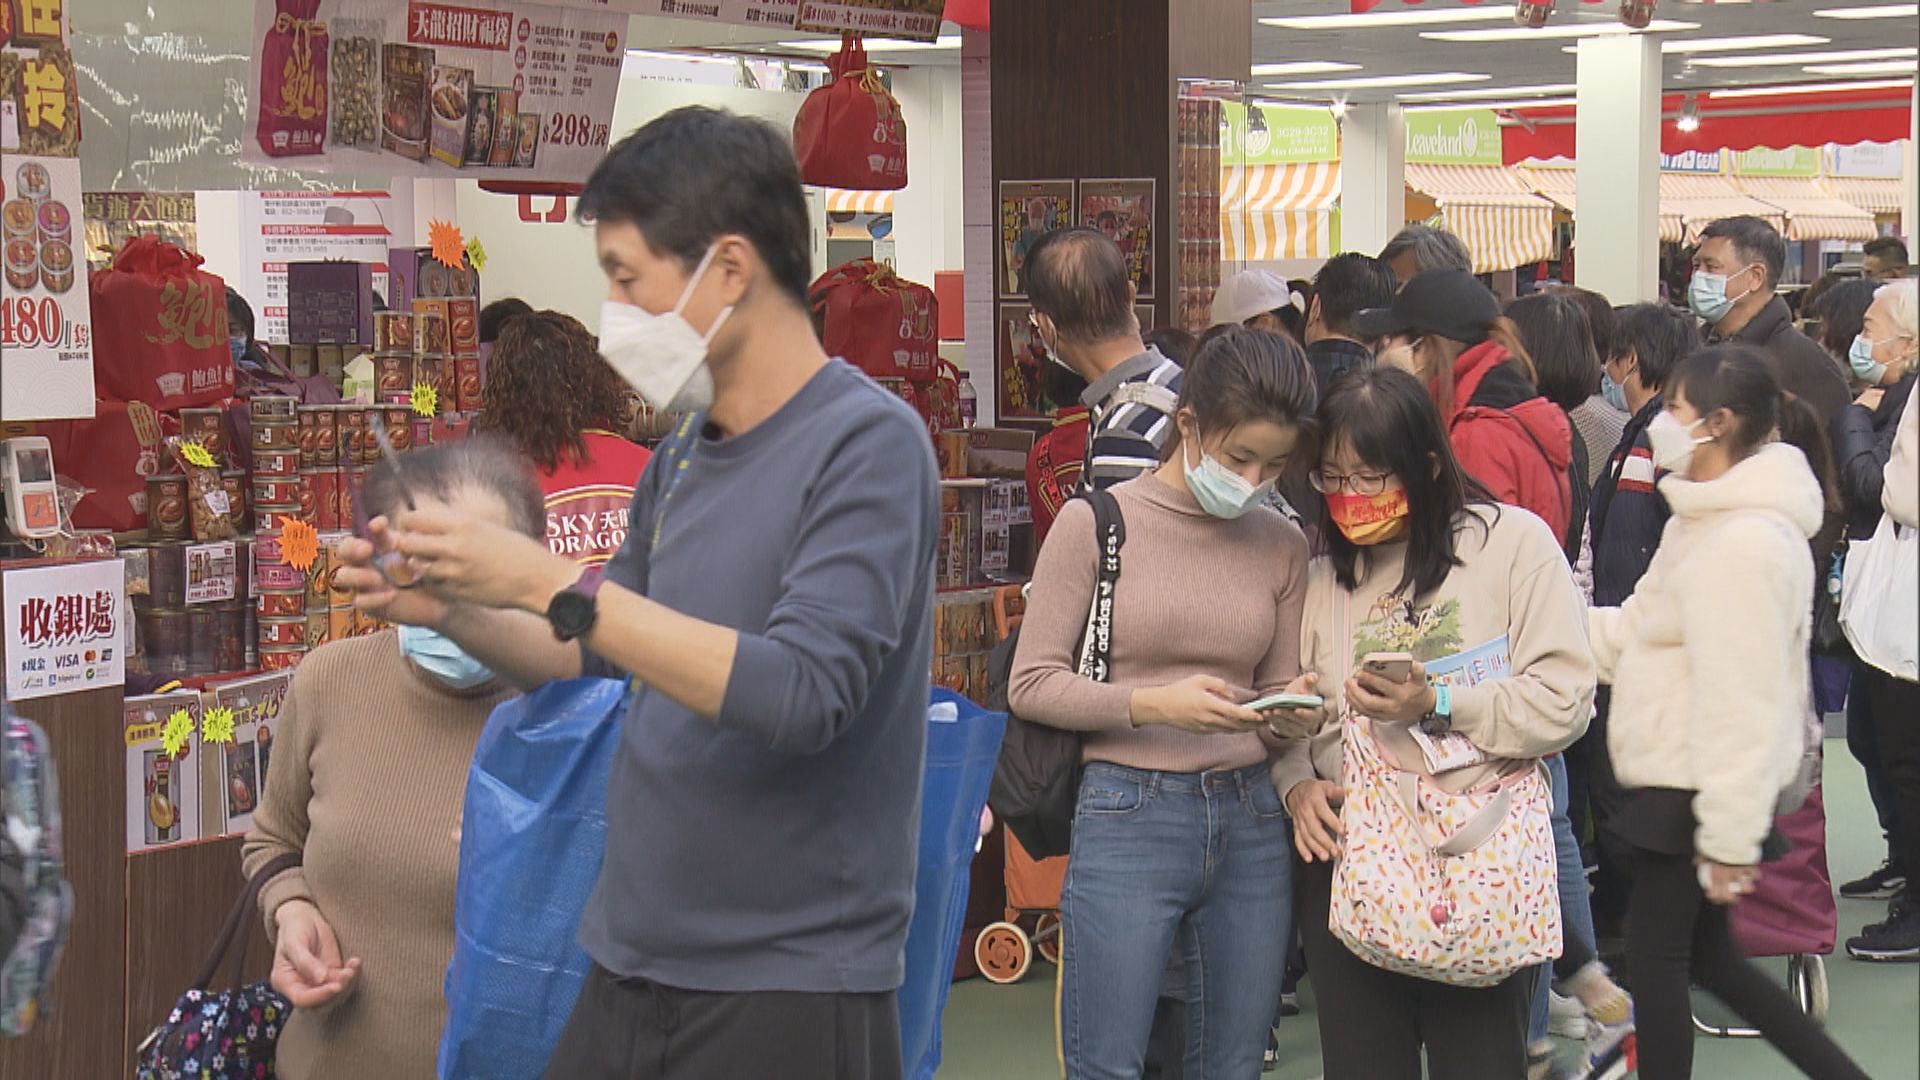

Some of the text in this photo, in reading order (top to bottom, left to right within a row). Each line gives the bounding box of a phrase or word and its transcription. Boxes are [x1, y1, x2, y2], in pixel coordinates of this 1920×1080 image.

[413, 8, 511, 47] 天龍招財福袋
[546, 511, 597, 537] SKY
[549, 530, 629, 555] DRAGO
[20, 589, 113, 647] 收銀處
[1098, 597, 1112, 653] adidas
[55, 653, 80, 669] VISA
